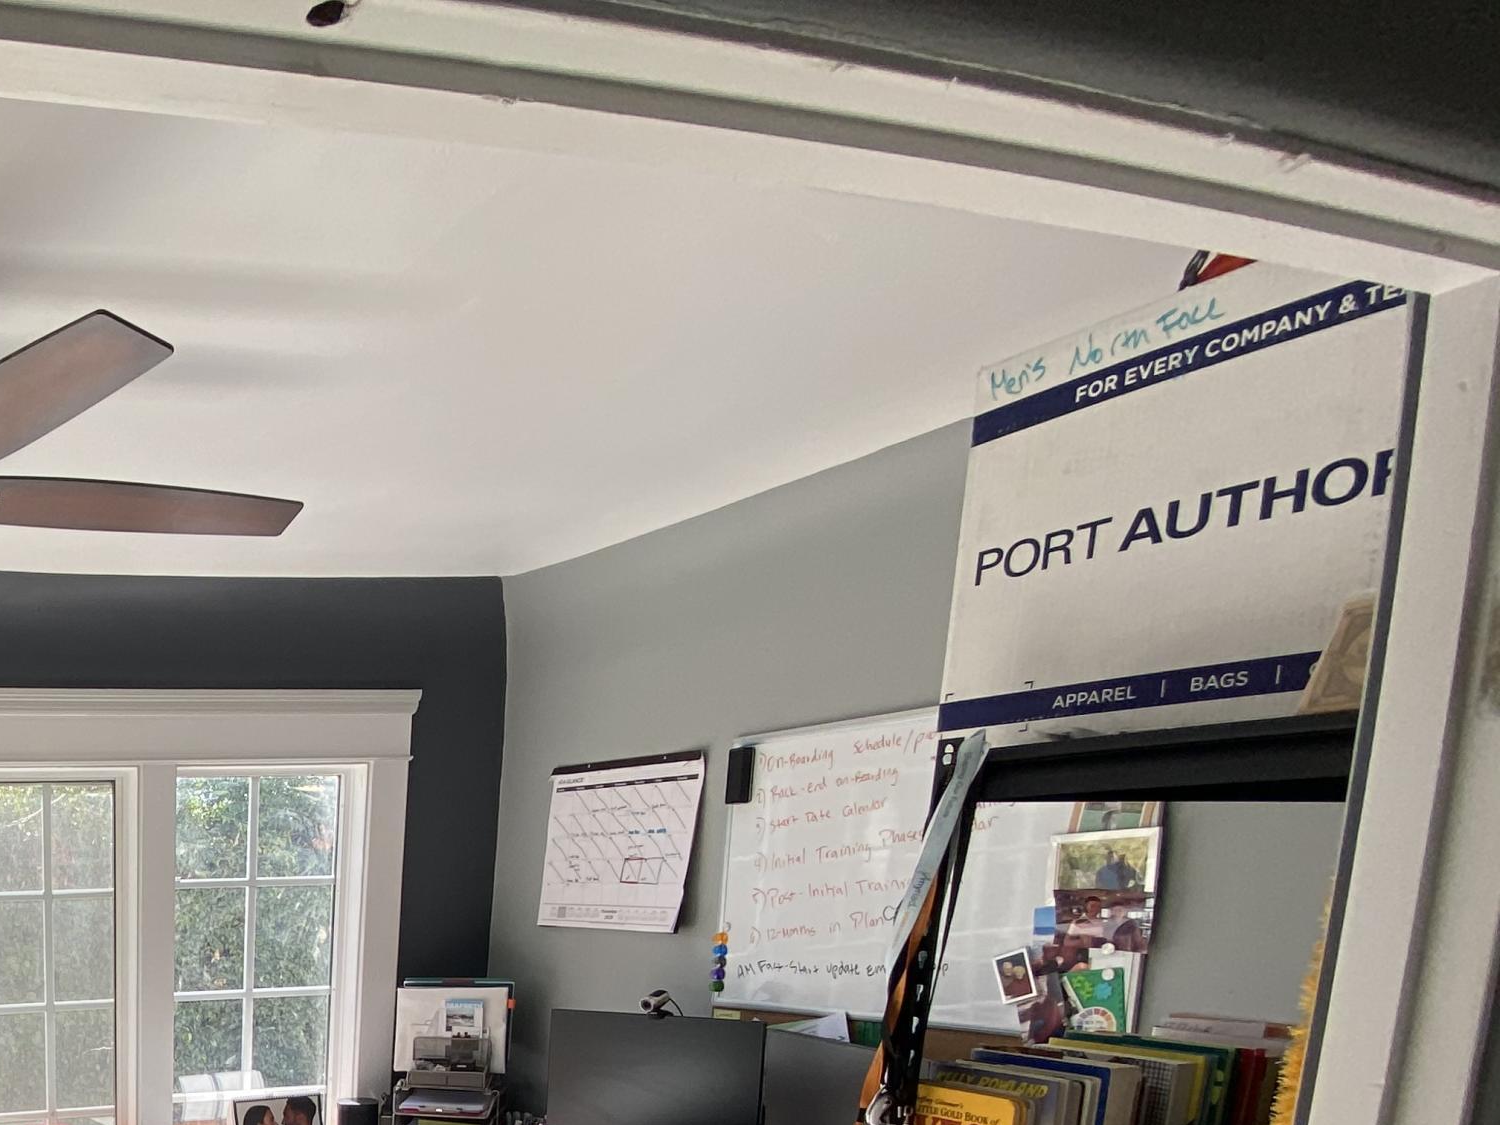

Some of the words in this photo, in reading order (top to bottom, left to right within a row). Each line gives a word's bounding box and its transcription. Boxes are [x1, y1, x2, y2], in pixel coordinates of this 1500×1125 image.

[1074, 374, 1118, 403] FOR
[1124, 346, 1199, 387] EVERY
[1205, 300, 1333, 358] COMPANY
[1337, 293, 1361, 315] &
[1365, 283, 1407, 306] TE
[974, 516, 1114, 587] PORT
[1052, 685, 1138, 710] APPAREL
[1190, 670, 1250, 693] BAGS
[815, 844, 872, 862] Training
